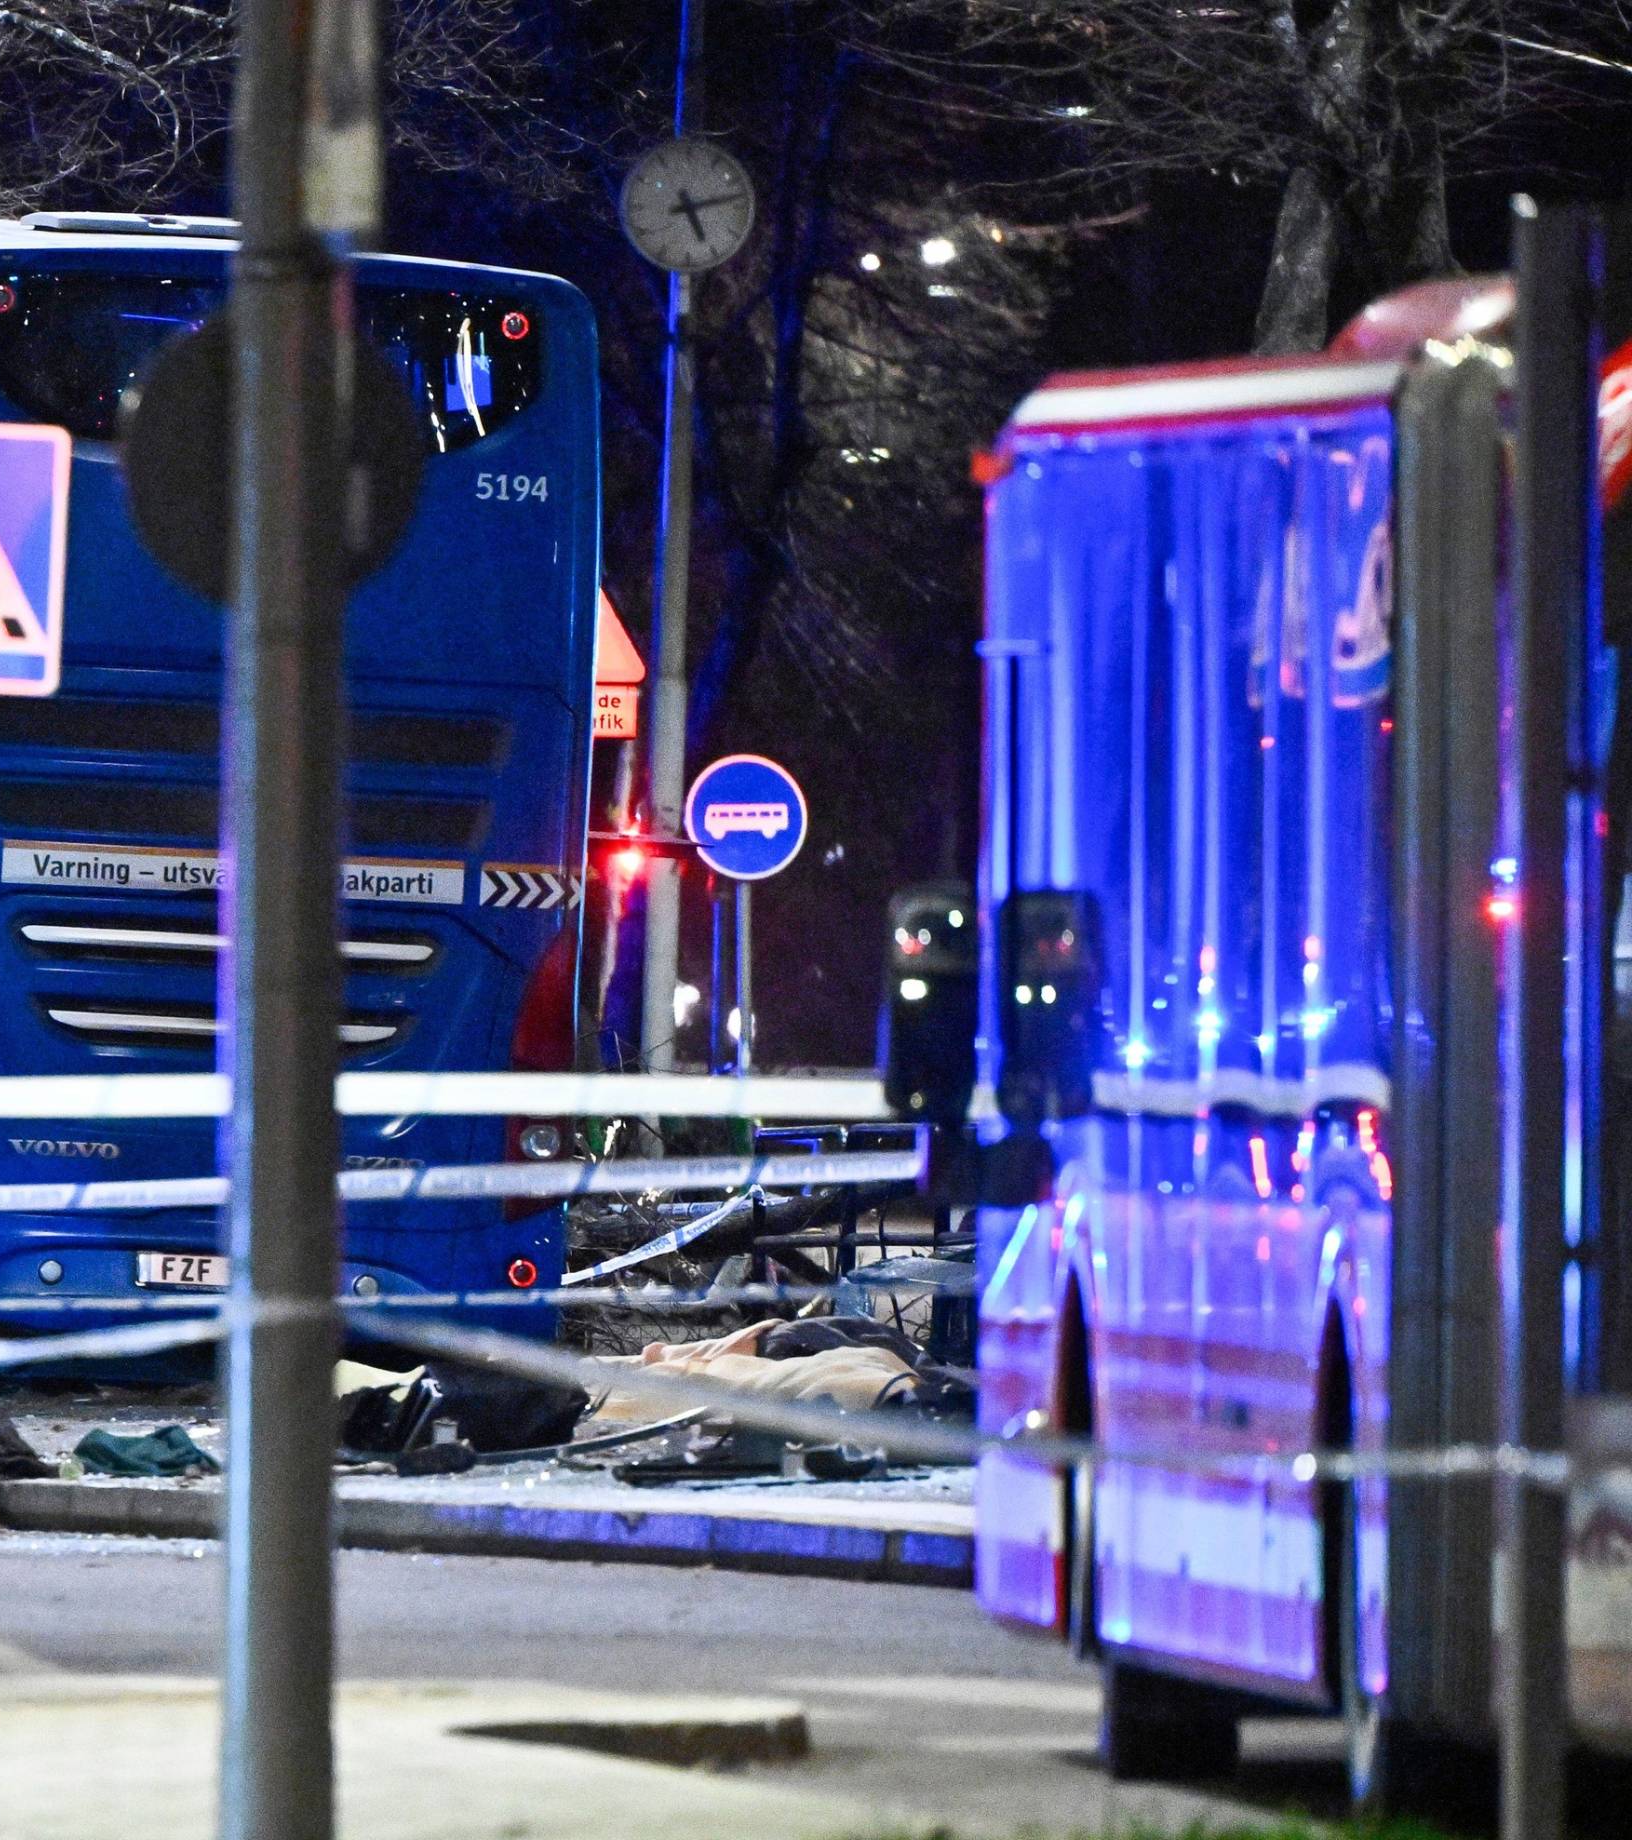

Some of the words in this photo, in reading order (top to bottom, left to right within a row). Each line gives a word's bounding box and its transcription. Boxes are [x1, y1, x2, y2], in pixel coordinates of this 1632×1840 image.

[475, 472, 549, 503] 5194
[598, 694, 622, 708] de
[593, 713, 624, 730] fik
[33, 853, 130, 884] Varning
[344, 869, 434, 897] akparti
[8, 1138, 120, 1159] VOLVO
[161, 1256, 212, 1282] FZF
